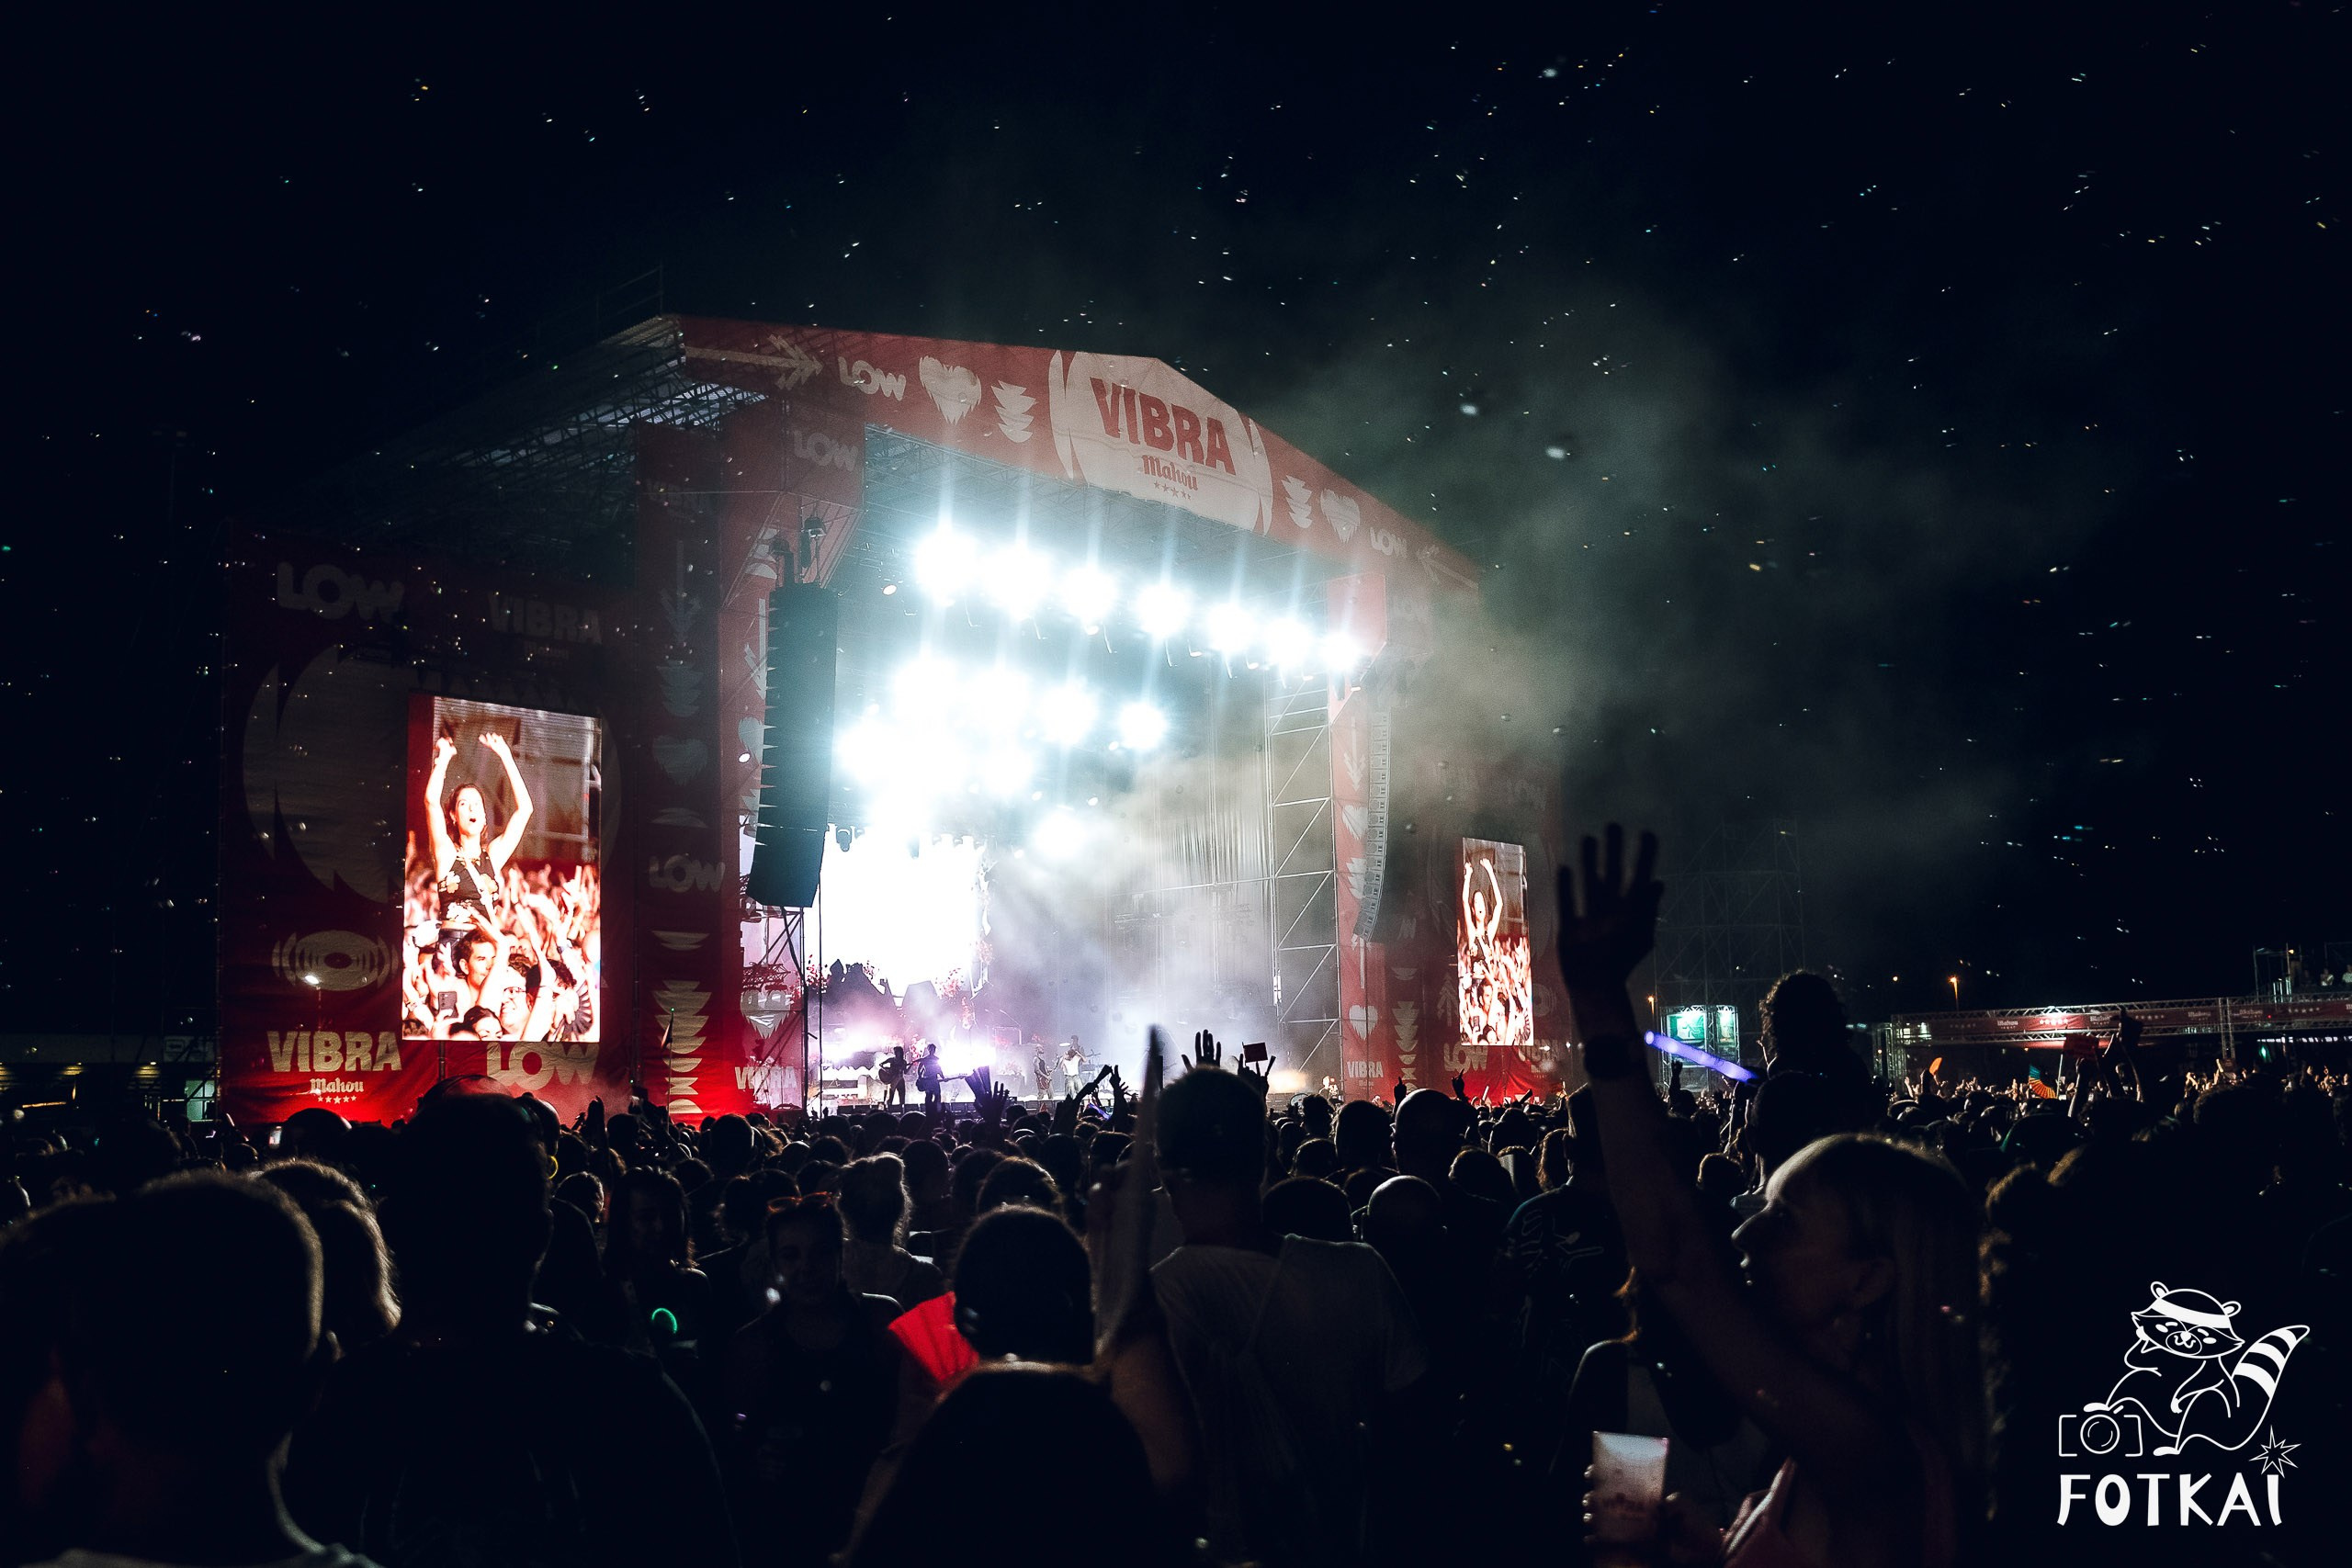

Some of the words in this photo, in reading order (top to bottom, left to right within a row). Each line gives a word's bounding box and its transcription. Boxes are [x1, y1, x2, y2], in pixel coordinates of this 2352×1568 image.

[838, 356, 906, 401] LOW
[1090, 377, 1237, 476] VIBRA
[793, 429, 859, 472] LOW
[1141, 455, 1198, 491] Mahou
[1369, 527, 1408, 559] LOW
[277, 561, 404, 624] LOW
[489, 592, 603, 645] VIBRA
[649, 854, 726, 893] LOW
[266, 1030, 402, 1073] VIBRA
[486, 1041, 600, 1091] LOW
[1346, 1061, 1384, 1078] VIBRA
[1443, 1042, 1488, 1075] LOW
[309, 1077, 365, 1094] Mahou
